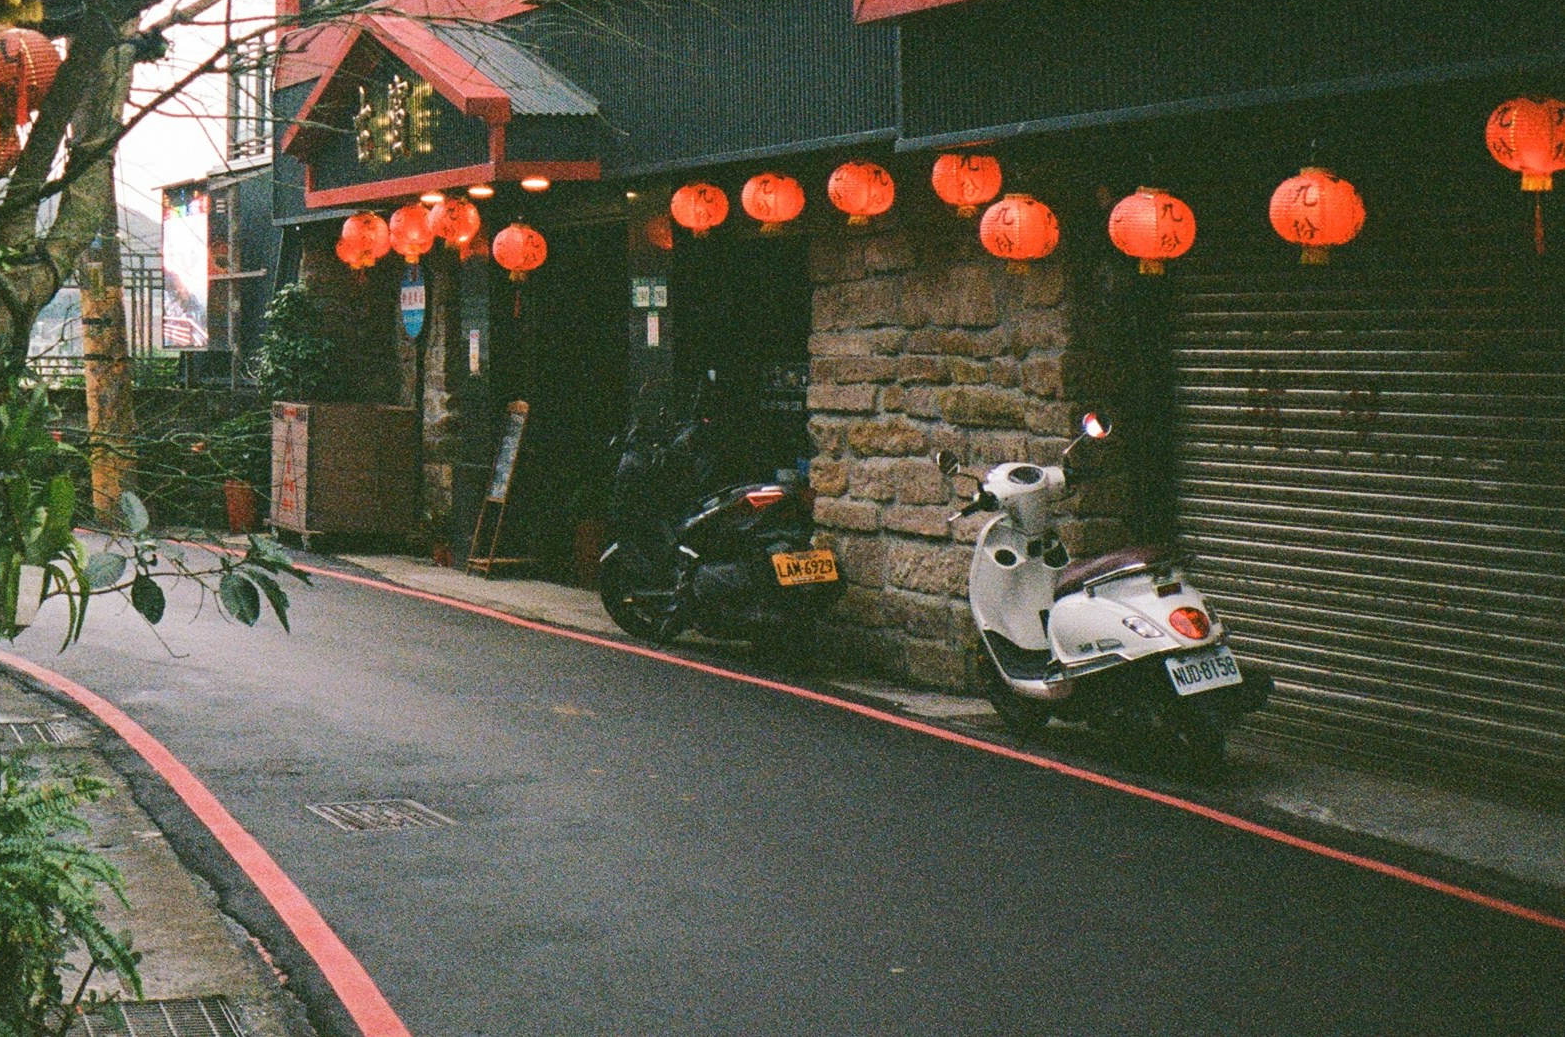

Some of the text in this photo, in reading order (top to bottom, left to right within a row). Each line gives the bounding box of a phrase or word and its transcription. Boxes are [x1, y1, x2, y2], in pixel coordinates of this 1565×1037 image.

[960, 155, 981, 197] 九份
[994, 207, 1015, 254] 九份
[1160, 203, 1183, 253] 九份
[1292, 184, 1320, 240] 九份
